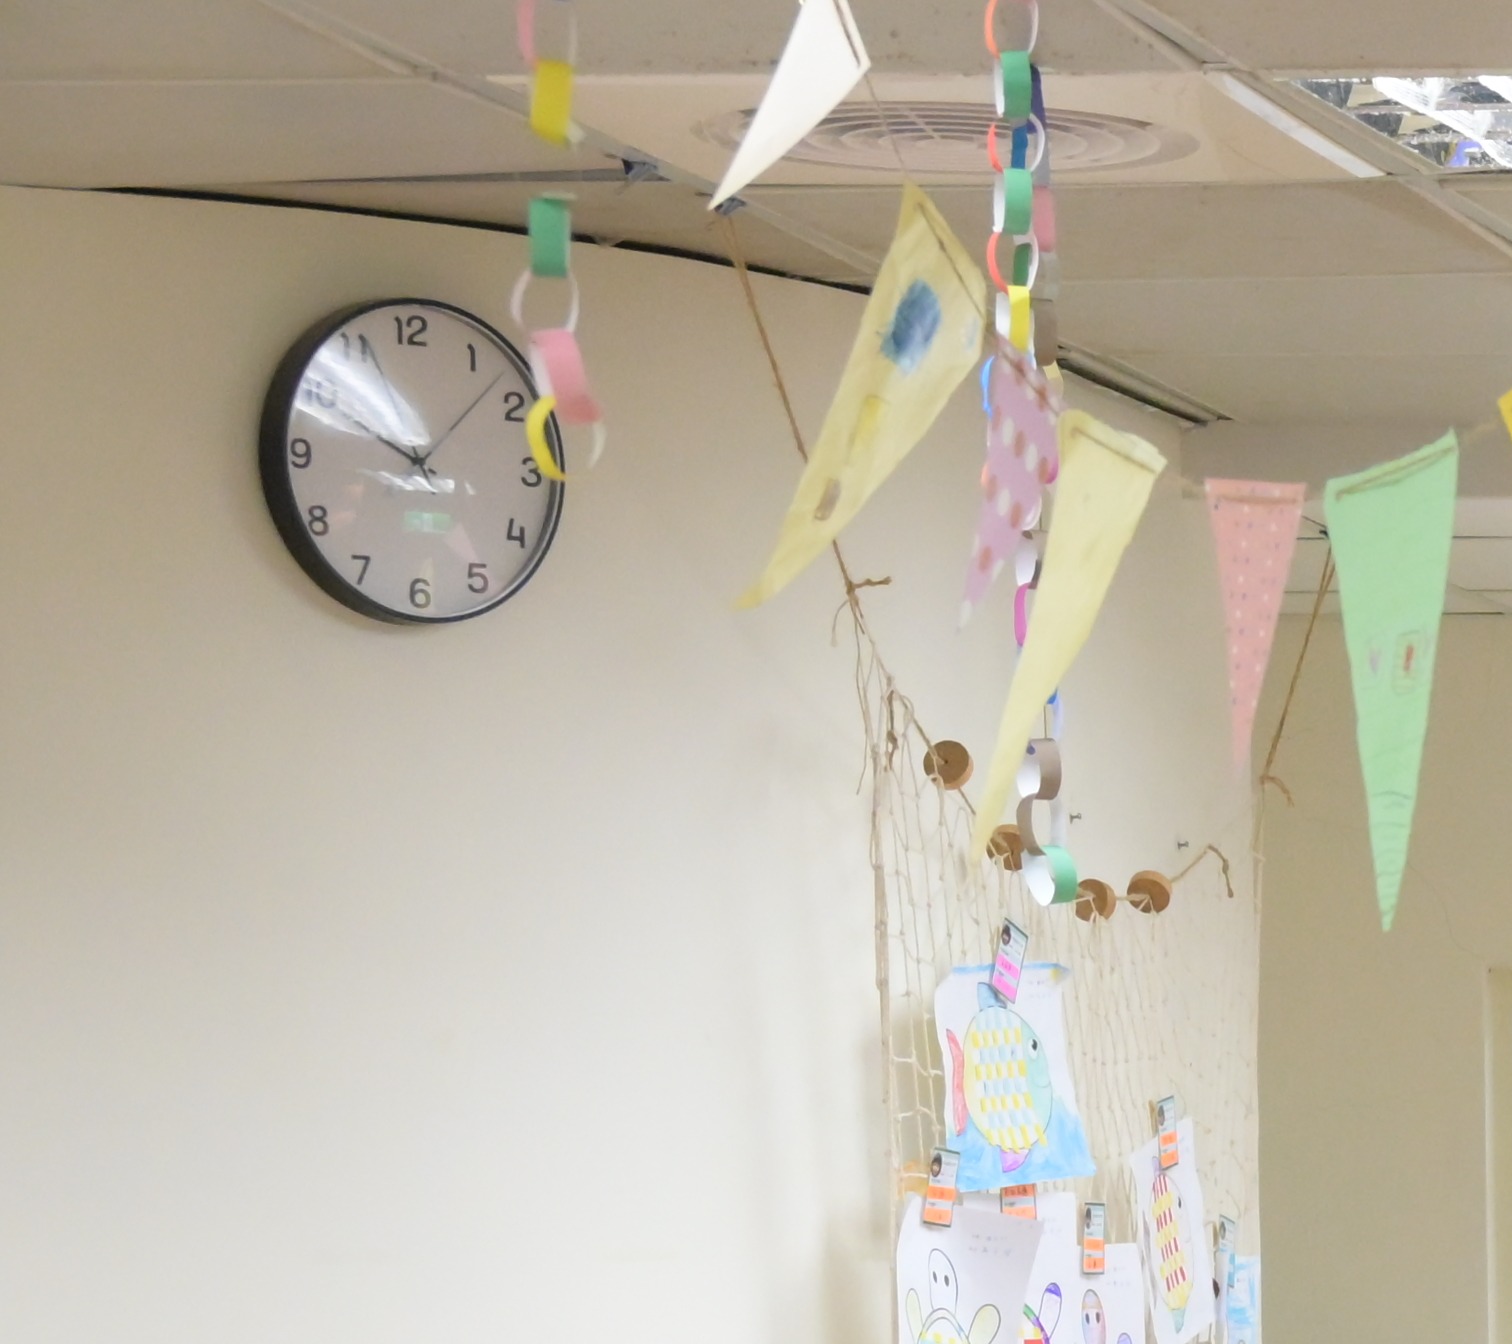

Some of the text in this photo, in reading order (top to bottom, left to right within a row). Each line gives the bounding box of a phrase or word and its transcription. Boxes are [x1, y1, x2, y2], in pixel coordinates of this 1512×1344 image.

[394, 315, 428, 347] 12
[341, 332, 368, 363] 11
[467, 343, 477, 372] 1
[504, 392, 526, 422] 2
[290, 438, 312, 469] 9
[521, 457, 543, 488] 3
[308, 505, 329, 536] 8
[506, 518, 526, 549] 4
[351, 555, 371, 585] 7
[467, 563, 489, 593] 5
[409, 578, 431, 608] 6
